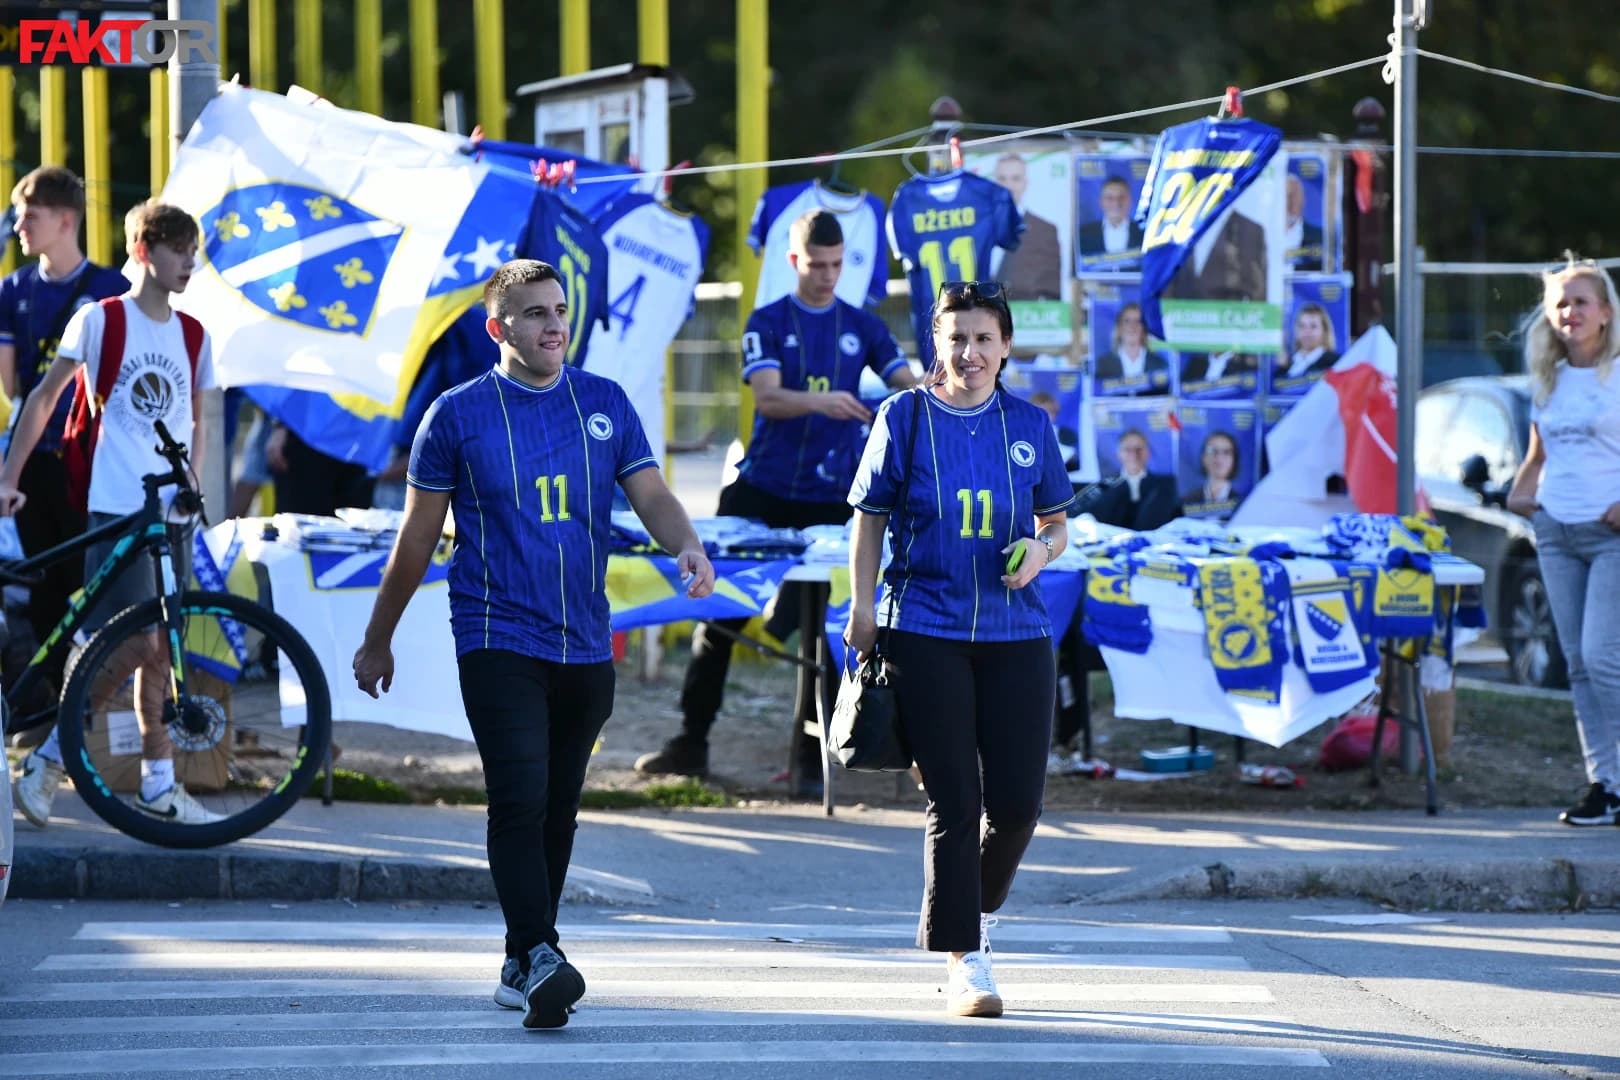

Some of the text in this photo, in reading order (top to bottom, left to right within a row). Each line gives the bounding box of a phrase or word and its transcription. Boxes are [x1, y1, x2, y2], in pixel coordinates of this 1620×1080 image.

[912, 205, 977, 234] DŽEKO
[918, 235, 977, 301] 11
[609, 274, 647, 343] 4
[535, 474, 571, 523] 11
[956, 488, 994, 539] 11
